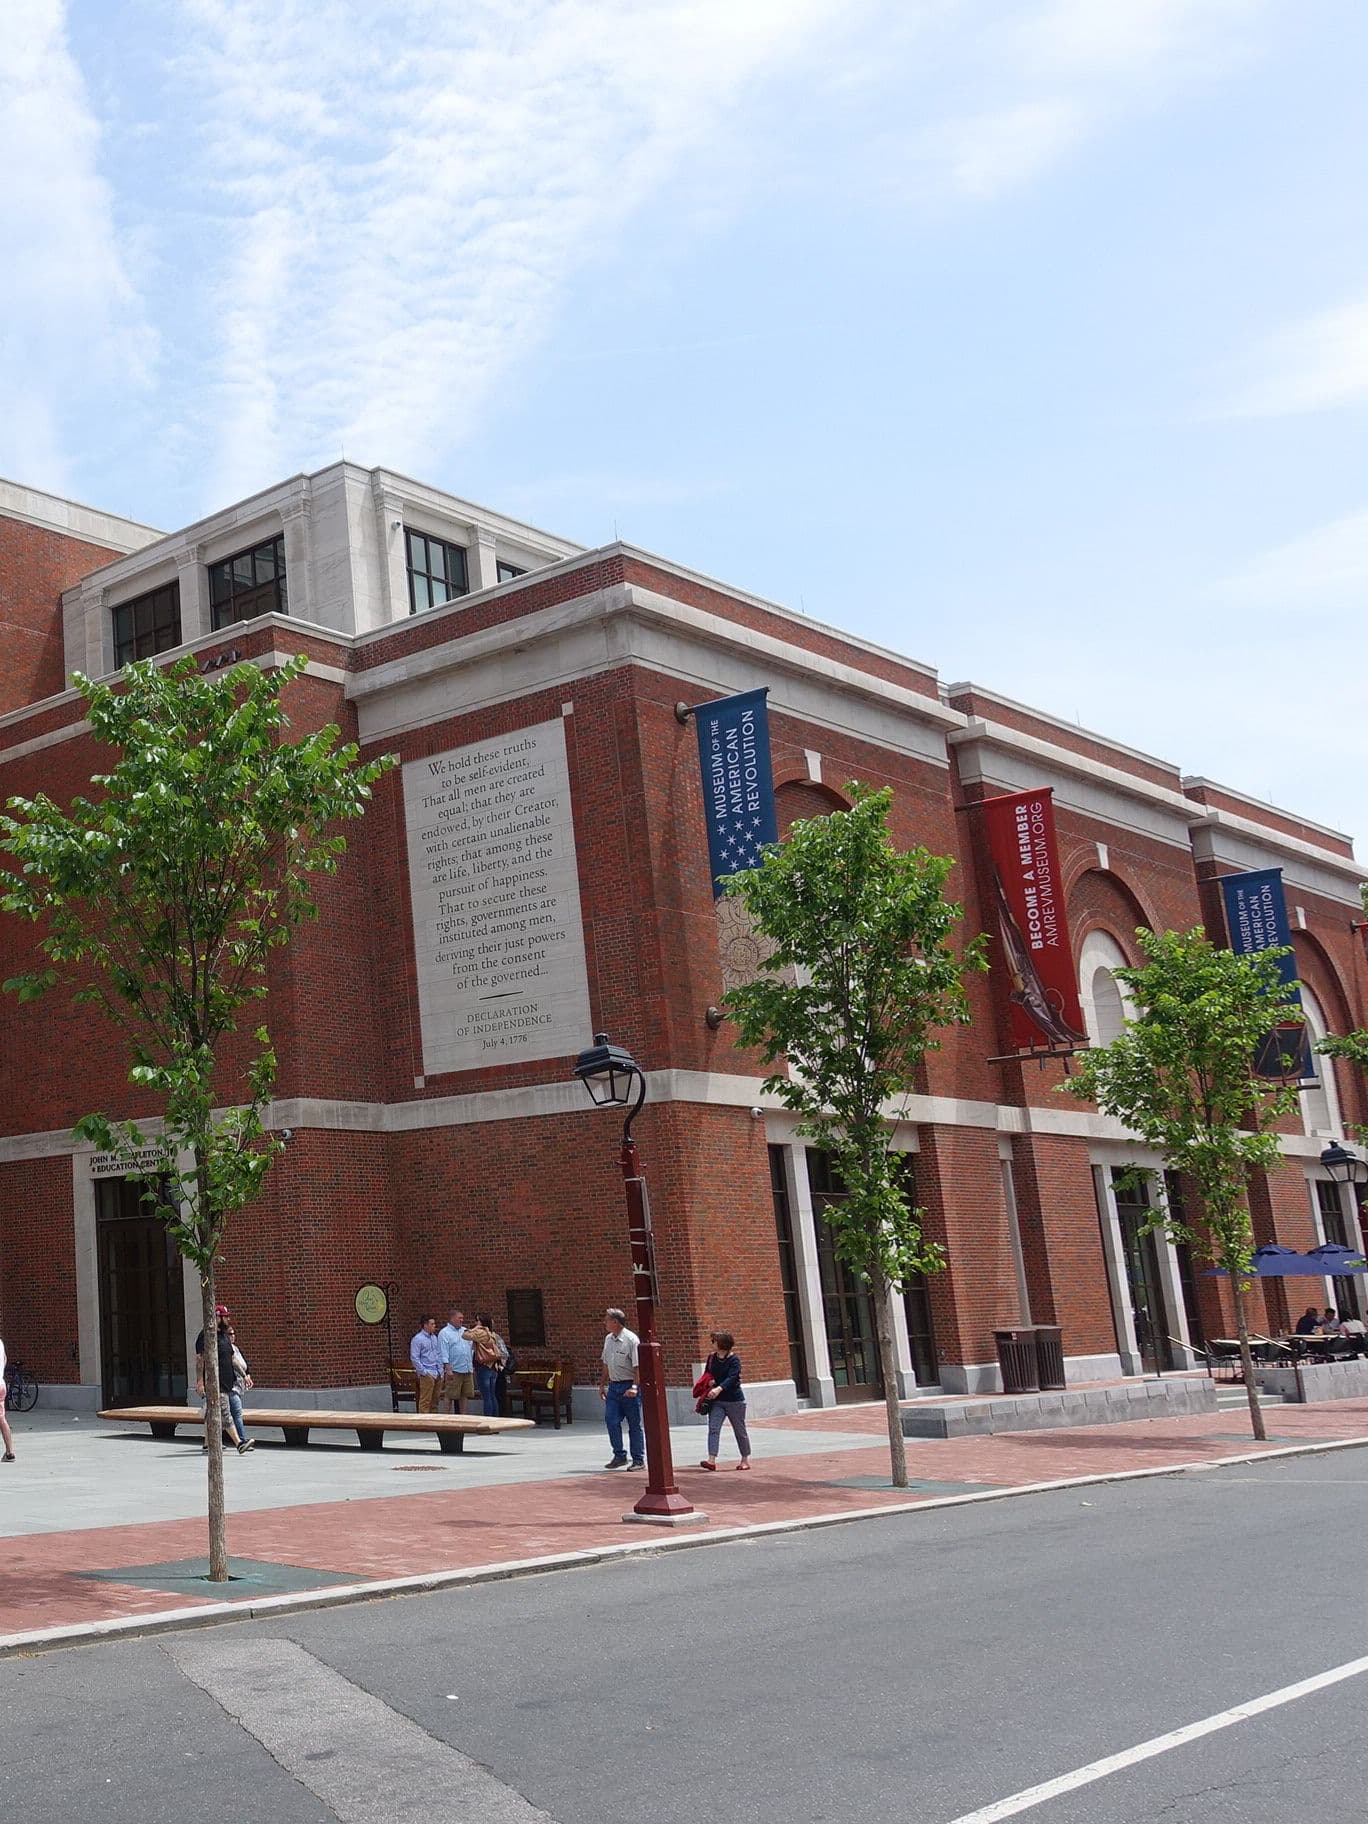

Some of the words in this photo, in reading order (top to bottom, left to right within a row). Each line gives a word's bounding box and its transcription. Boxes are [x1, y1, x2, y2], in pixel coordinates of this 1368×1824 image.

[710, 720, 719, 737] THE
[712, 738, 720, 751] OF
[428, 760, 446, 776] We
[449, 755, 470, 771] hold
[474, 750, 500, 764] these
[504, 739, 536, 755] truths
[442, 778, 452, 788] to
[455, 772, 466, 785] be
[469, 757, 530, 780] self-evident,
[726, 728, 743, 814] AMERICAN
[742, 710, 760, 812] REVOLUTION
[422, 795, 446, 808] That
[449, 789, 460, 802] all
[464, 785, 486, 797] men
[489, 779, 504, 791] are
[507, 766, 544, 785] created
[711, 753, 727, 819] MUSEUM
[421, 822, 470, 840] endowed,
[473, 817, 485, 828] by
[486, 810, 511, 824] their
[515, 799, 559, 817] Creator,
[438, 802, 468, 820] equal;
[471, 797, 491, 810] that
[495, 792, 516, 806] they
[520, 787, 535, 798] are
[426, 841, 448, 854] with
[452, 832, 487, 848] certain
[491, 815, 550, 838] unalienable
[1016, 804, 1034, 865] MEMBER
[428, 856, 458, 872] rights;
[461, 850, 482, 863] that
[485, 842, 521, 858] among
[526, 832, 553, 845] these
[432, 873, 447, 884] are
[449, 867, 470, 880] life,
[473, 858, 509, 875] liberty,
[512, 852, 531, 865] and
[536, 847, 552, 859] the
[439, 883, 476, 902] pursuit
[479, 878, 490, 890] of
[492, 868, 547, 891] happiness.
[1023, 870, 1034, 881] A
[1031, 802, 1059, 947] AMREVMUSEUM.ORG
[436, 917, 468, 933] rights,
[471, 903, 537, 927] governments
[541, 898, 557, 909] are
[439, 903, 464, 916] That
[468, 900, 479, 909] to
[482, 892, 515, 906] secure
[520, 884, 547, 898] these
[1239, 902, 1245, 910] OF
[439, 927, 488, 944] instituted
[491, 919, 526, 934] among
[529, 914, 556, 925] men,
[1025, 887, 1043, 950] BECOME
[1239, 910, 1254, 952] MUSEUM
[1249, 896, 1265, 950] AMERICAN
[435, 948, 475, 963] deriving
[478, 942, 502, 954] their
[505, 937, 524, 950] just
[528, 930, 565, 948] powers
[452, 963, 478, 975] from
[482, 958, 498, 969] the
[501, 950, 545, 965] consent
[457, 979, 469, 990] of
[472, 975, 488, 987] the
[491, 965, 548, 985] governed...
[457, 1027, 469, 1037] OF
[473, 1014, 552, 1034] INDEPENDENCE
[467, 1004, 538, 1023] DECLARATION
[483, 1036, 497, 1049] July
[510, 1035, 527, 1044] 1776
[90, 1155, 107, 1166] JOHN
[97, 1162, 138, 1172] EDUCATION
